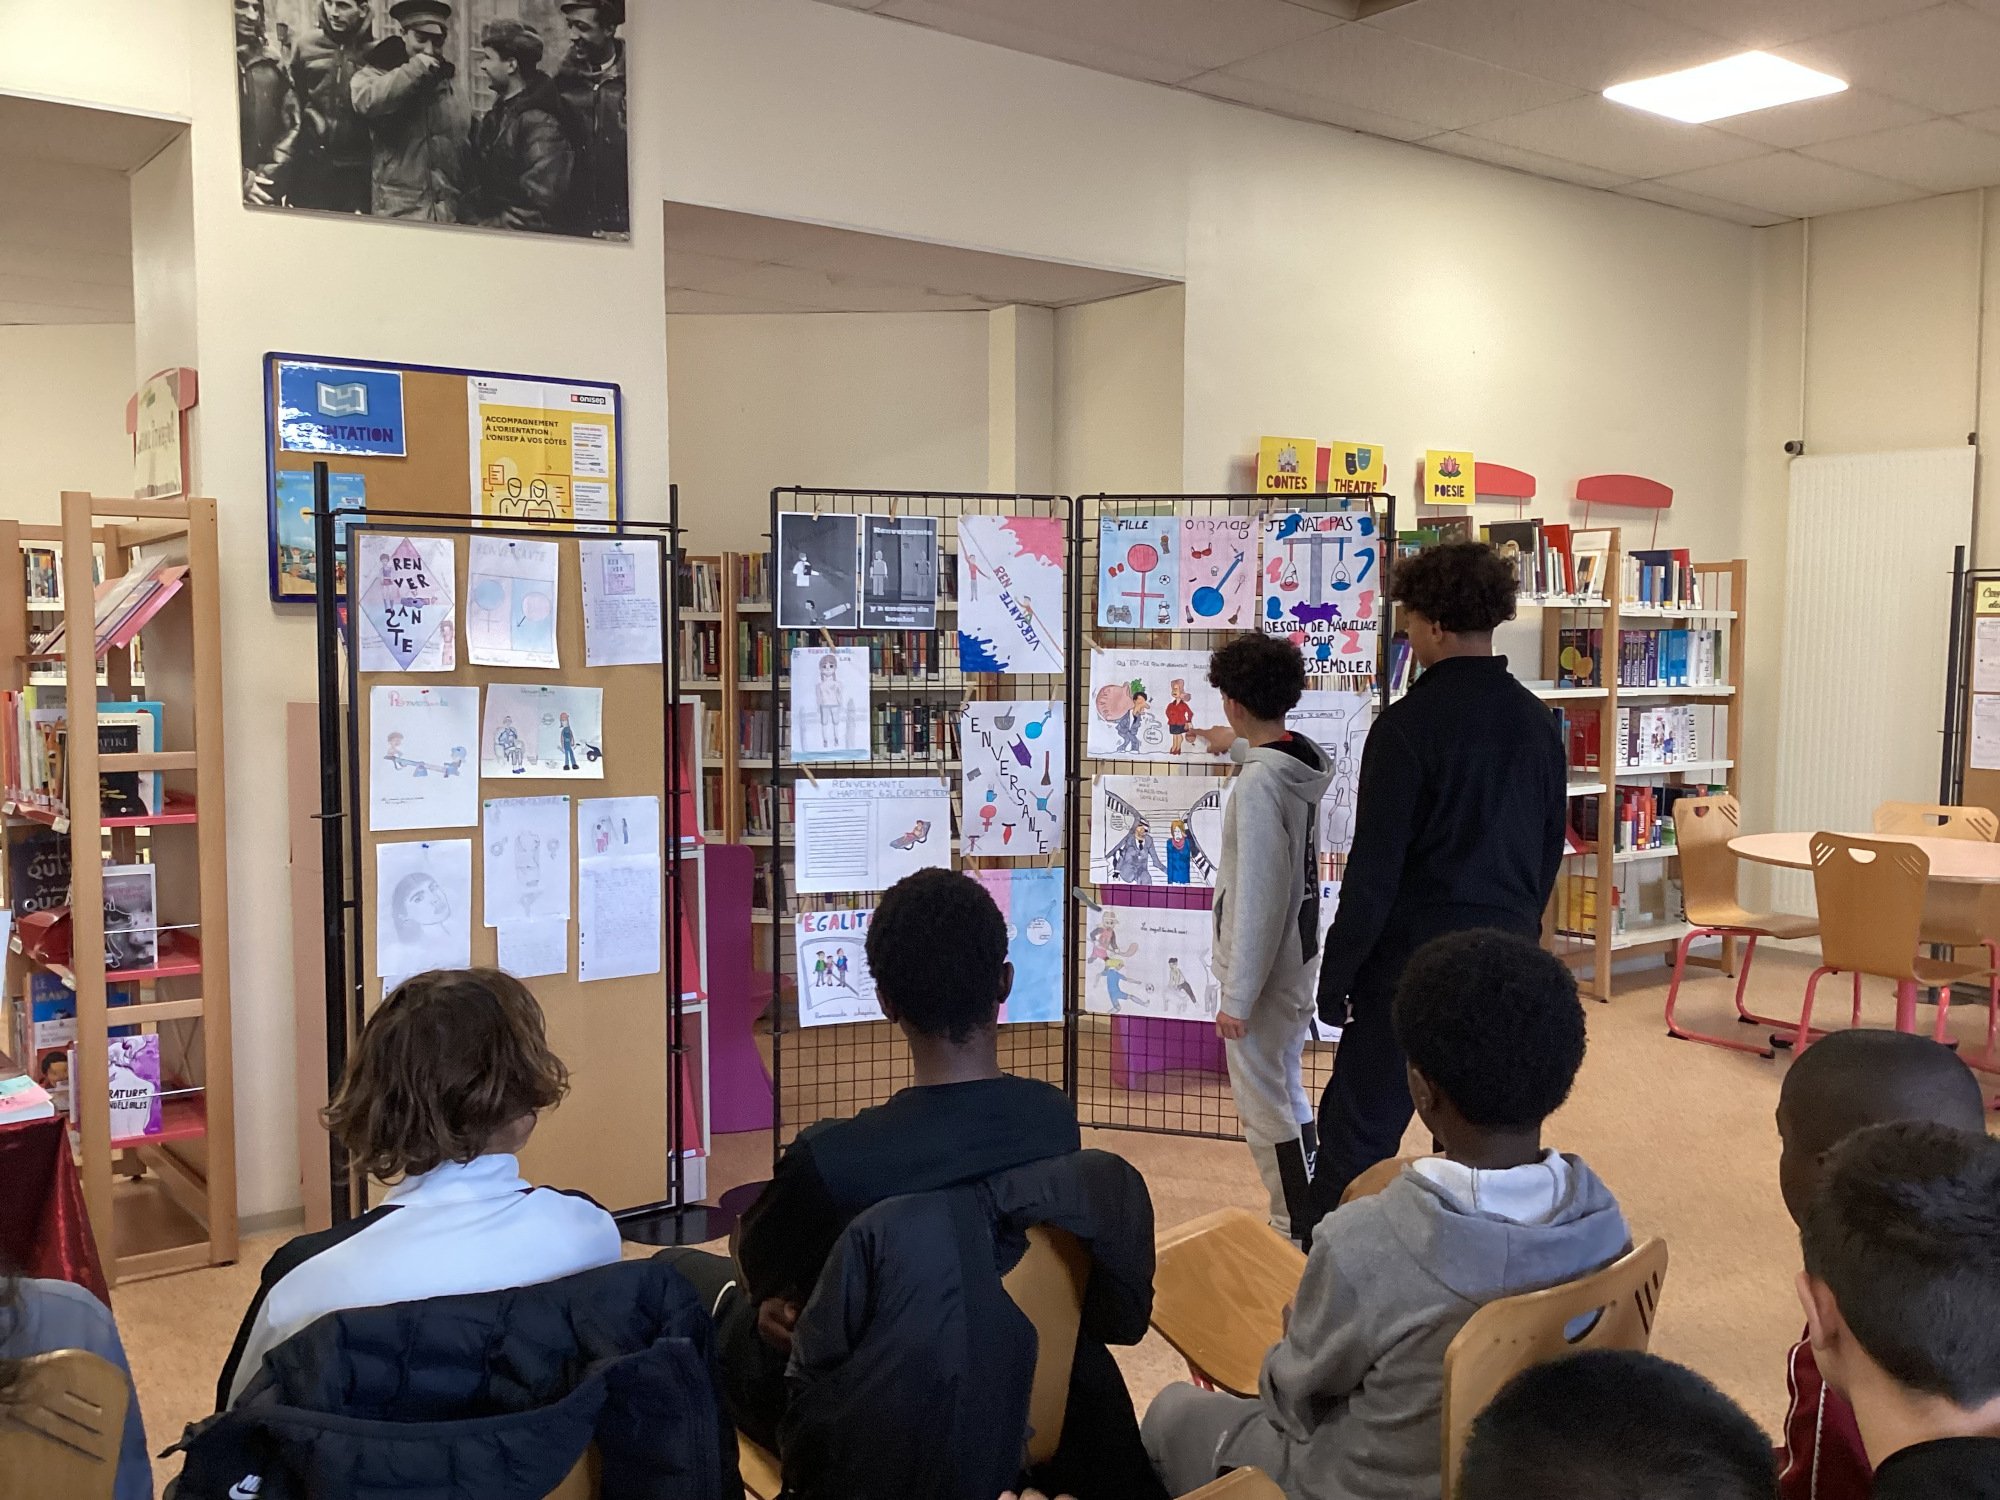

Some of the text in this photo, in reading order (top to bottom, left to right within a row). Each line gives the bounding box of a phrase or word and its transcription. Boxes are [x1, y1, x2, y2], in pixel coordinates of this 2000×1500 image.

[579, 396, 606, 405] onisep
[485, 415, 559, 428] ACCOMPAGNEMENT
[493, 427, 549, 436] L'ORIENTATION
[486, 434, 519, 442] L'ONISEP
[544, 437, 568, 447] CÔTÉS
[1266, 474, 1308, 491] CONTES
[1334, 478, 1379, 494] THEATRE
[1434, 484, 1465, 498] POESIE
[1118, 519, 1149, 531] FILLE
[1265, 519, 1287, 532] JE
[1329, 515, 1354, 532] PAS
[392, 557, 422, 572] REN
[394, 573, 430, 590] VER
[993, 565, 1013, 589] REN
[999, 591, 1041, 652] VERSANTE
[1264, 621, 1306, 633] BESOIN
[1311, 621, 1324, 632] DE
[387, 628, 413, 653] TE
[1303, 635, 1335, 648] POUR
[832, 780, 905, 789] RENVERSANTE
